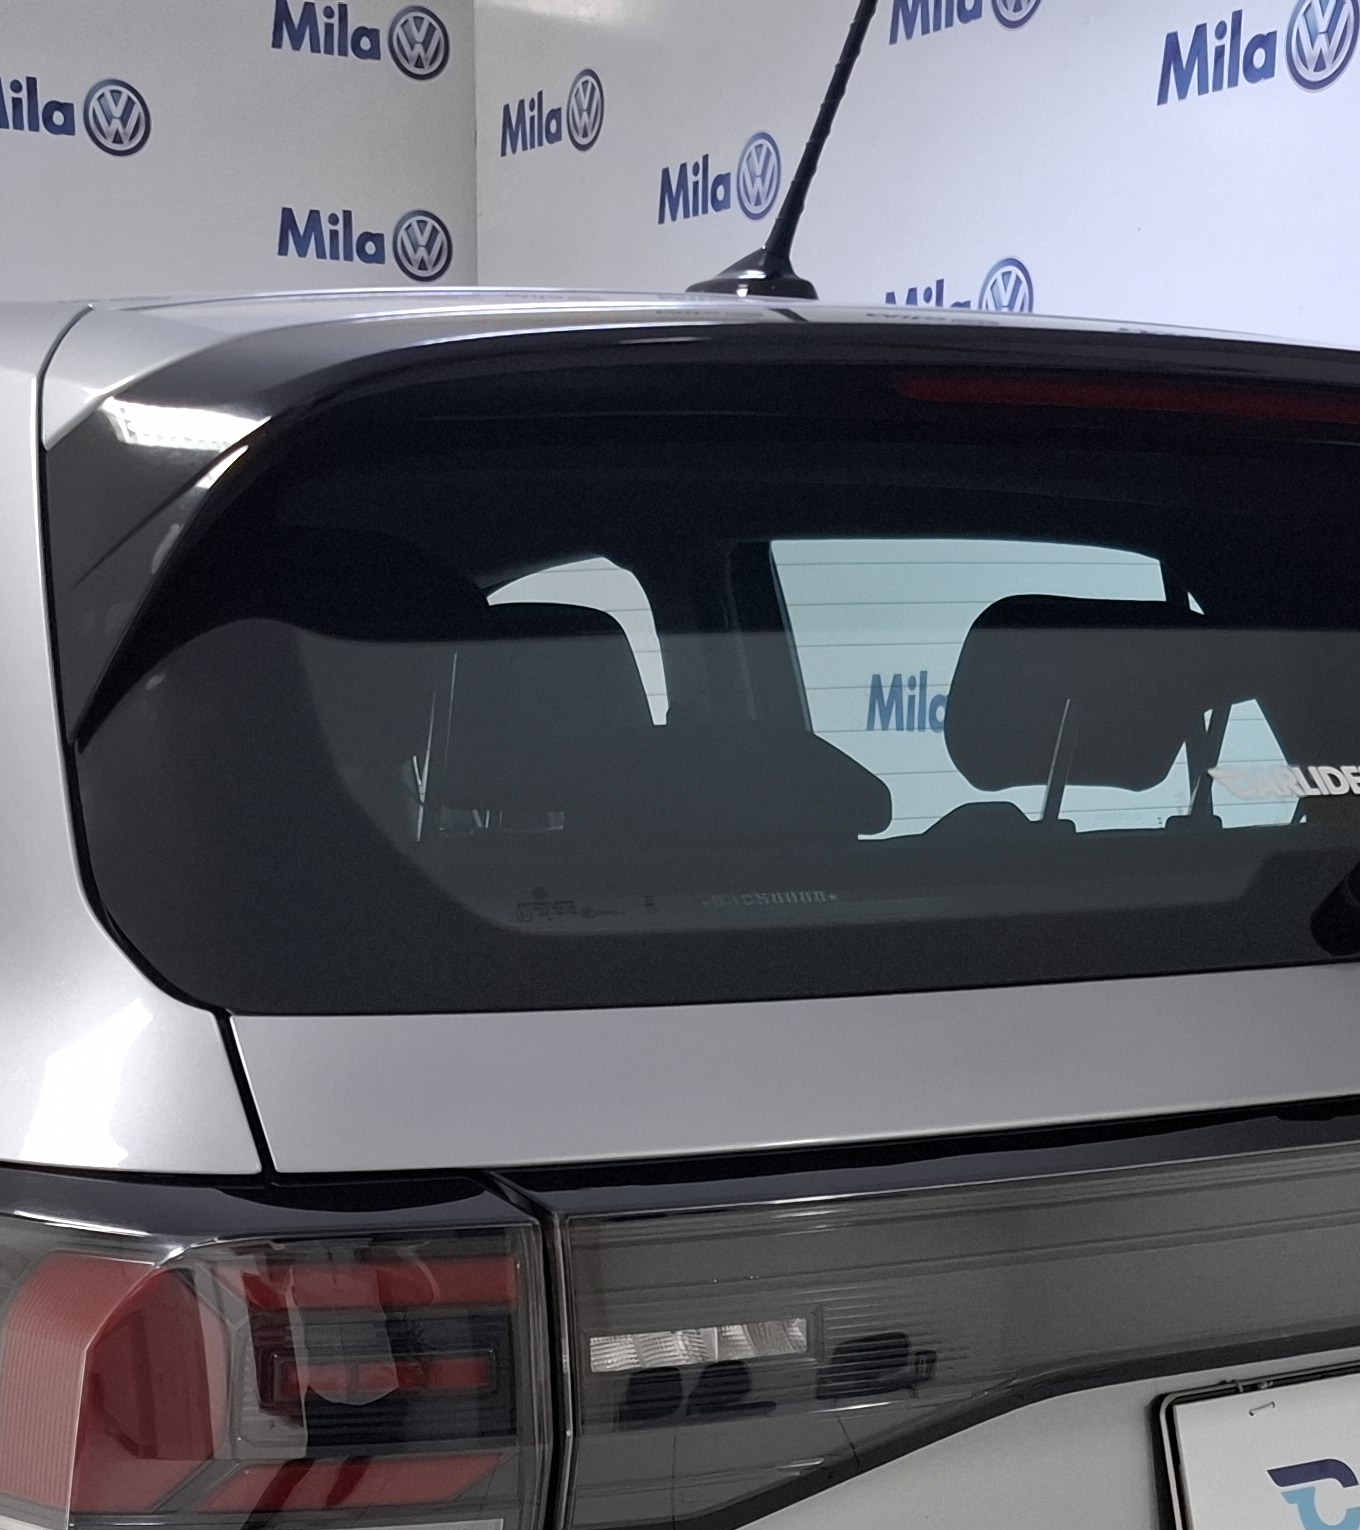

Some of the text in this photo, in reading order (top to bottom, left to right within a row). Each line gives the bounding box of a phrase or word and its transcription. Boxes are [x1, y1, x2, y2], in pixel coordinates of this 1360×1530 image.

[271, 0, 382, 61] Mila
[1157, 9, 1277, 106] Mila
[500, 89, 563, 158] Mila
[658, 153, 732, 225] Mila
[277, 207, 386, 265] Mila
[866, 670, 948, 733] Mila
